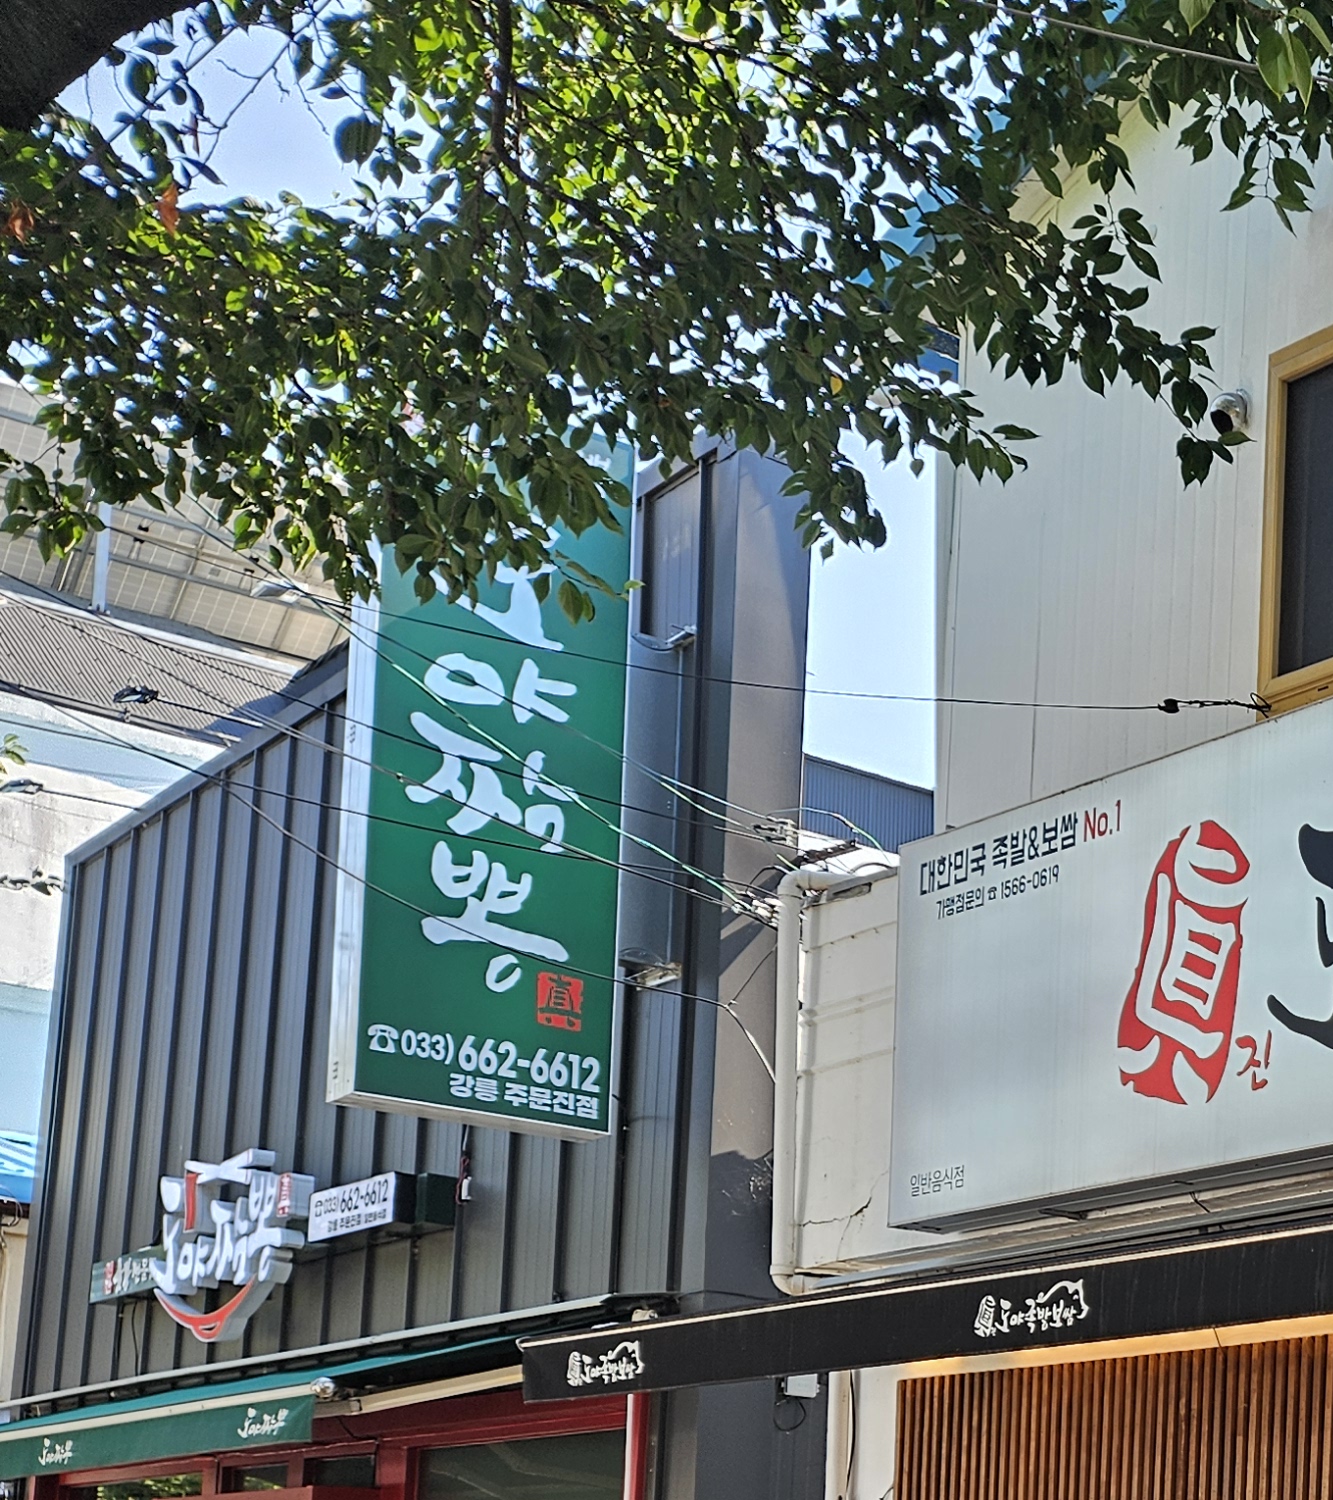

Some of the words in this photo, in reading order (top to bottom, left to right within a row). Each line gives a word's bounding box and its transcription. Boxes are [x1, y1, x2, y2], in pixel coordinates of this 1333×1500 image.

[919, 842, 987, 896] 대한민국
[991, 812, 1079, 869] 족발&보쌈
[1083, 799, 1121, 842] No.1
[936, 886, 985, 920] 가맹점문의
[1000, 864, 1060, 899] 1566-0619
[400, 1027, 601, 1094] 033)662-6612
[1236, 1031, 1272, 1091] 진
[448, 1071, 498, 1103] 강릉
[502, 1079, 600, 1120] 주문진점
[909, 1164, 965, 1197] 일반음식점
